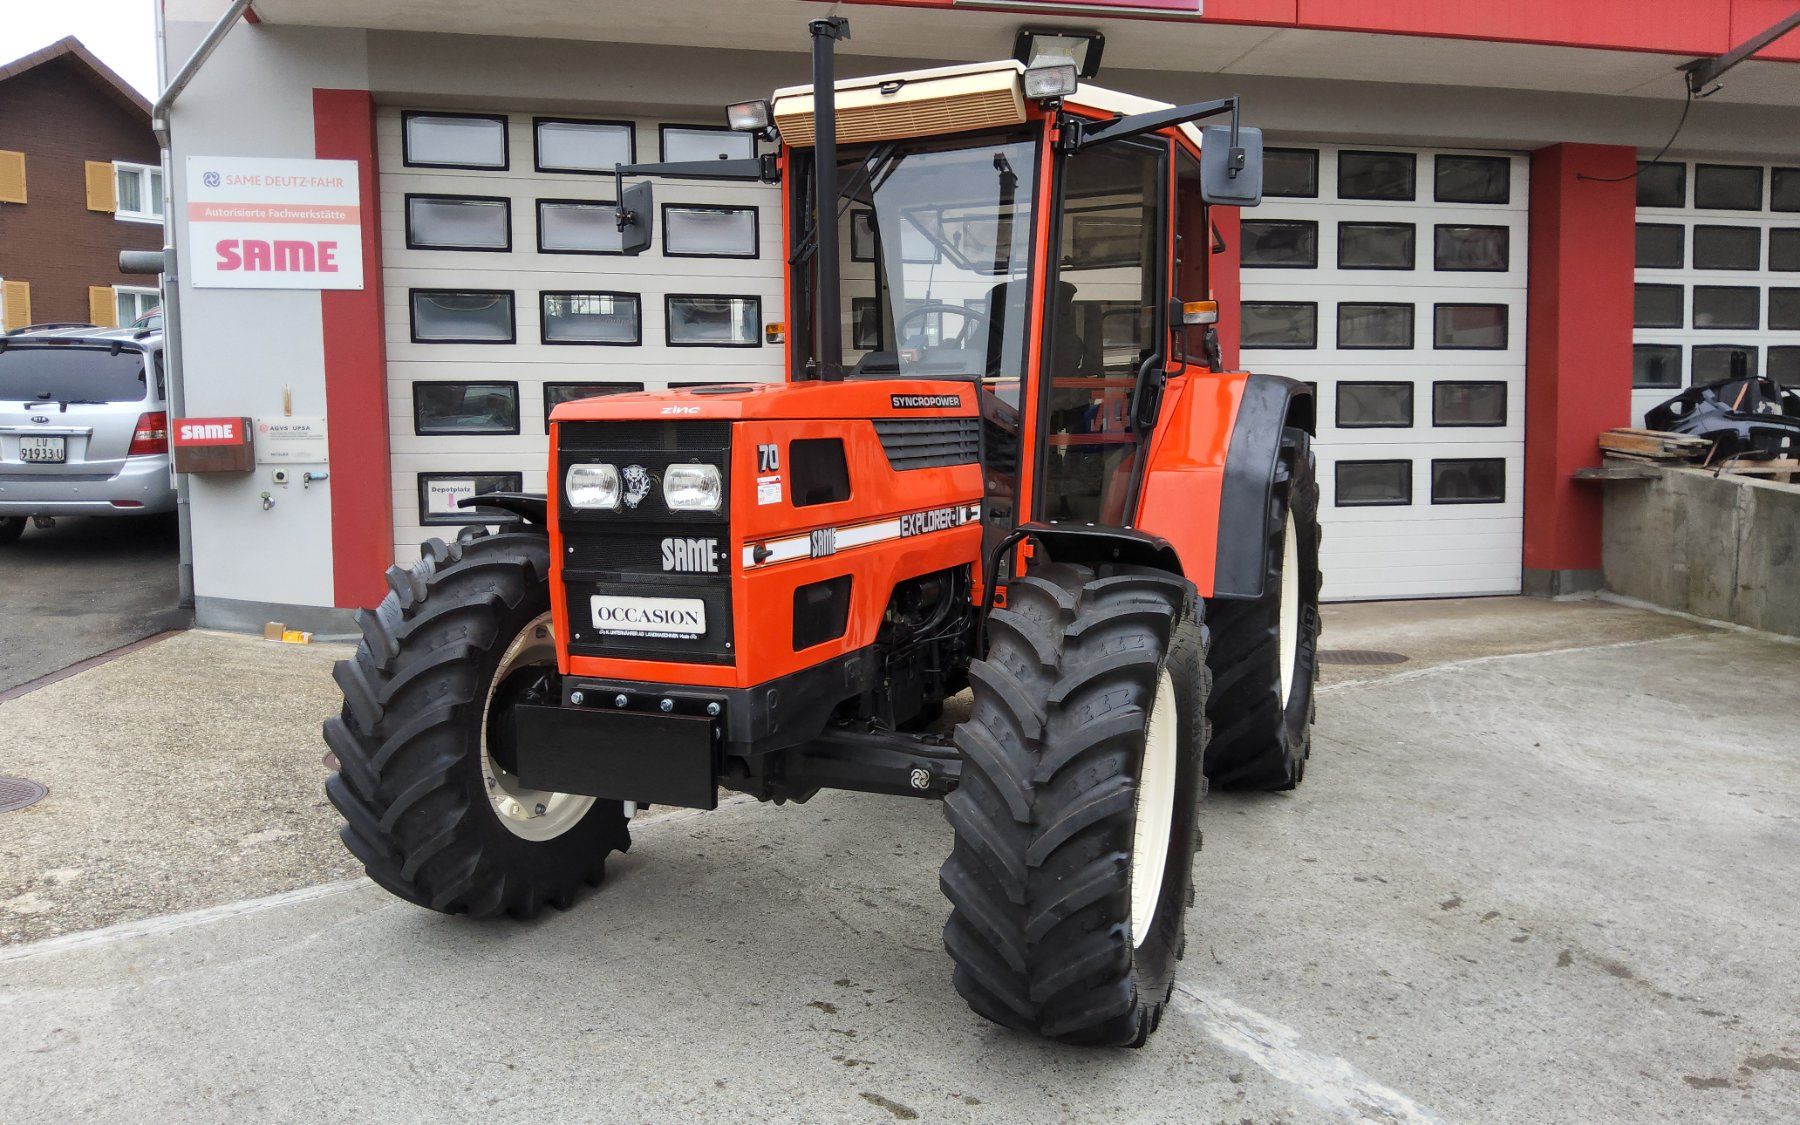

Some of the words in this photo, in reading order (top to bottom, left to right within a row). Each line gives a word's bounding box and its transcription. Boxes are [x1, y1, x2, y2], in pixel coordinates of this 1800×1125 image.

[226, 174, 261, 186] SAME
[265, 175, 344, 188] DEUTZ-FAHR
[205, 207, 266, 218] Autorisierte
[268, 208, 346, 219] Fachwerkstätte
[215, 239, 339, 272] SAME
[892, 396, 960, 408] SYNCROPOWER
[180, 424, 234, 440] SAME
[36, 439, 48, 447] LU
[758, 444, 780, 472] 70
[431, 486, 471, 494] Depotplatz
[811, 527, 837, 558] SAME
[661, 537, 719, 573] SAME
[597, 606, 699, 625] OCCASION
